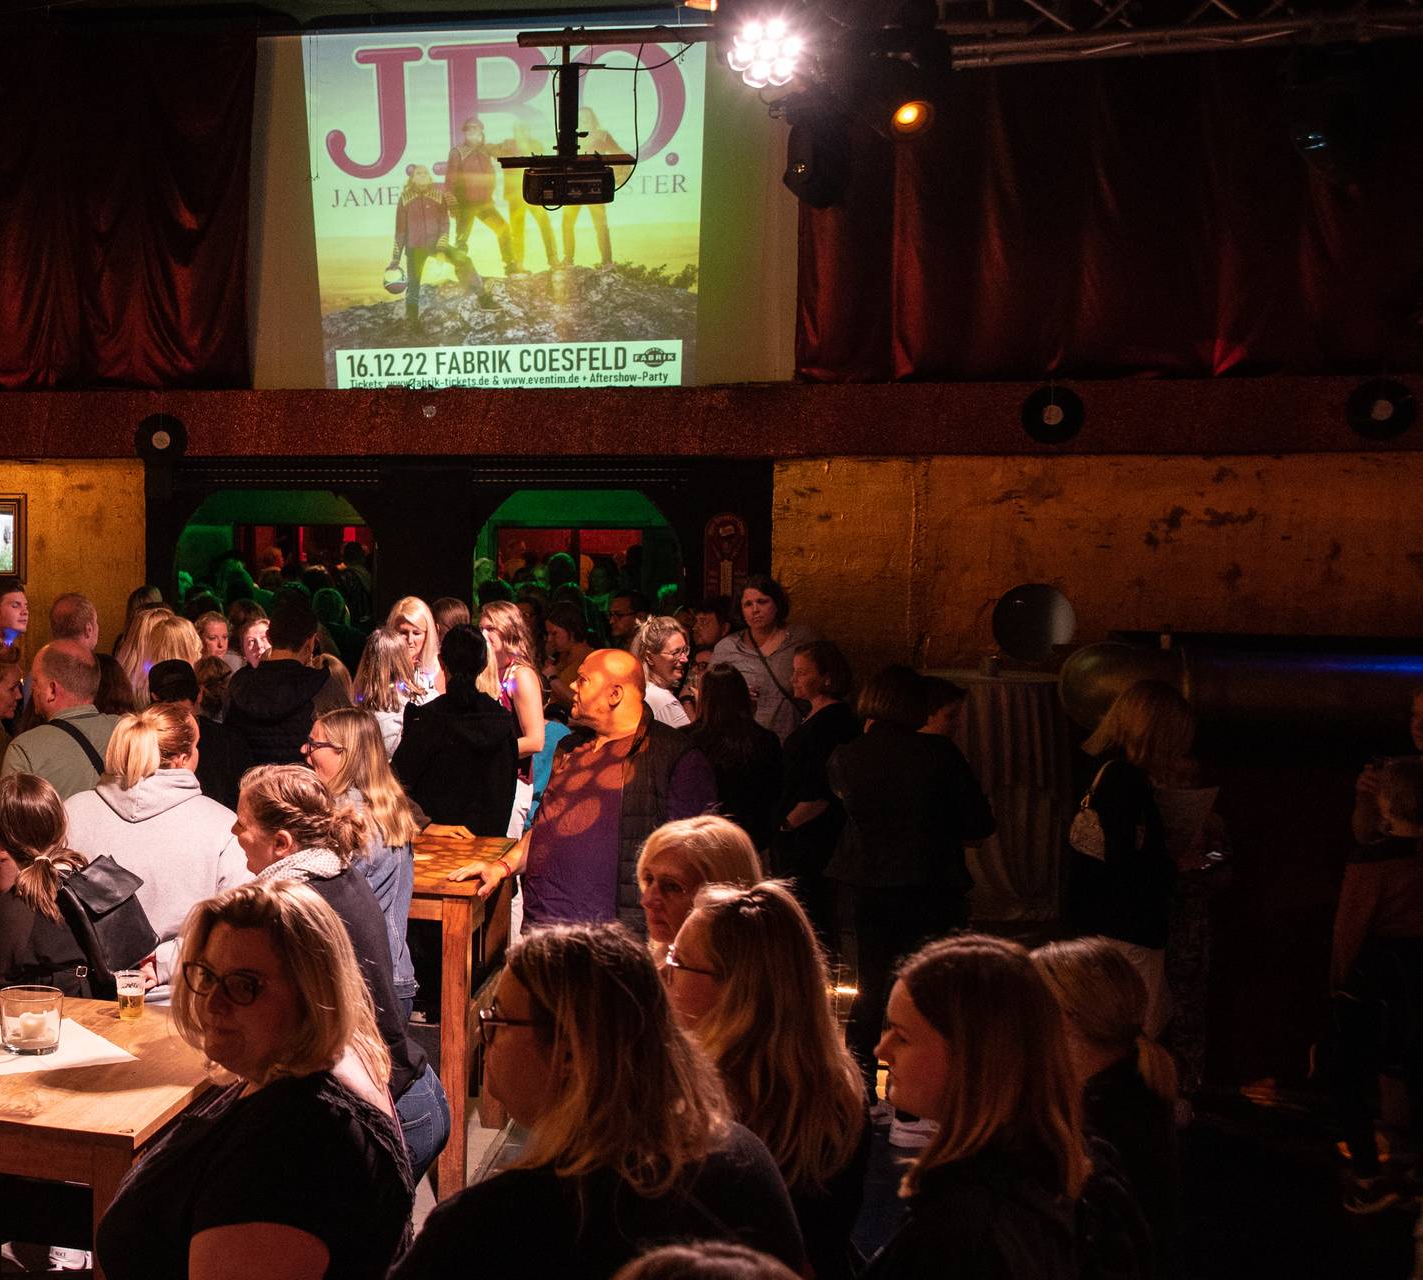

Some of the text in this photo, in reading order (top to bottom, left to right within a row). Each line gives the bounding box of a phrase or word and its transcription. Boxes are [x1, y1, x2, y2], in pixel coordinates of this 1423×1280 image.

[332, 185, 402, 208] JAME
[347, 347, 627, 378] 16.12.22 FABRIK COESFELD
[634, 353, 676, 362] FABRIK
[492, 376, 500, 386] &
[502, 373, 579, 386] www.eventim.de
[589, 371, 668, 384] Aftershow-Party
